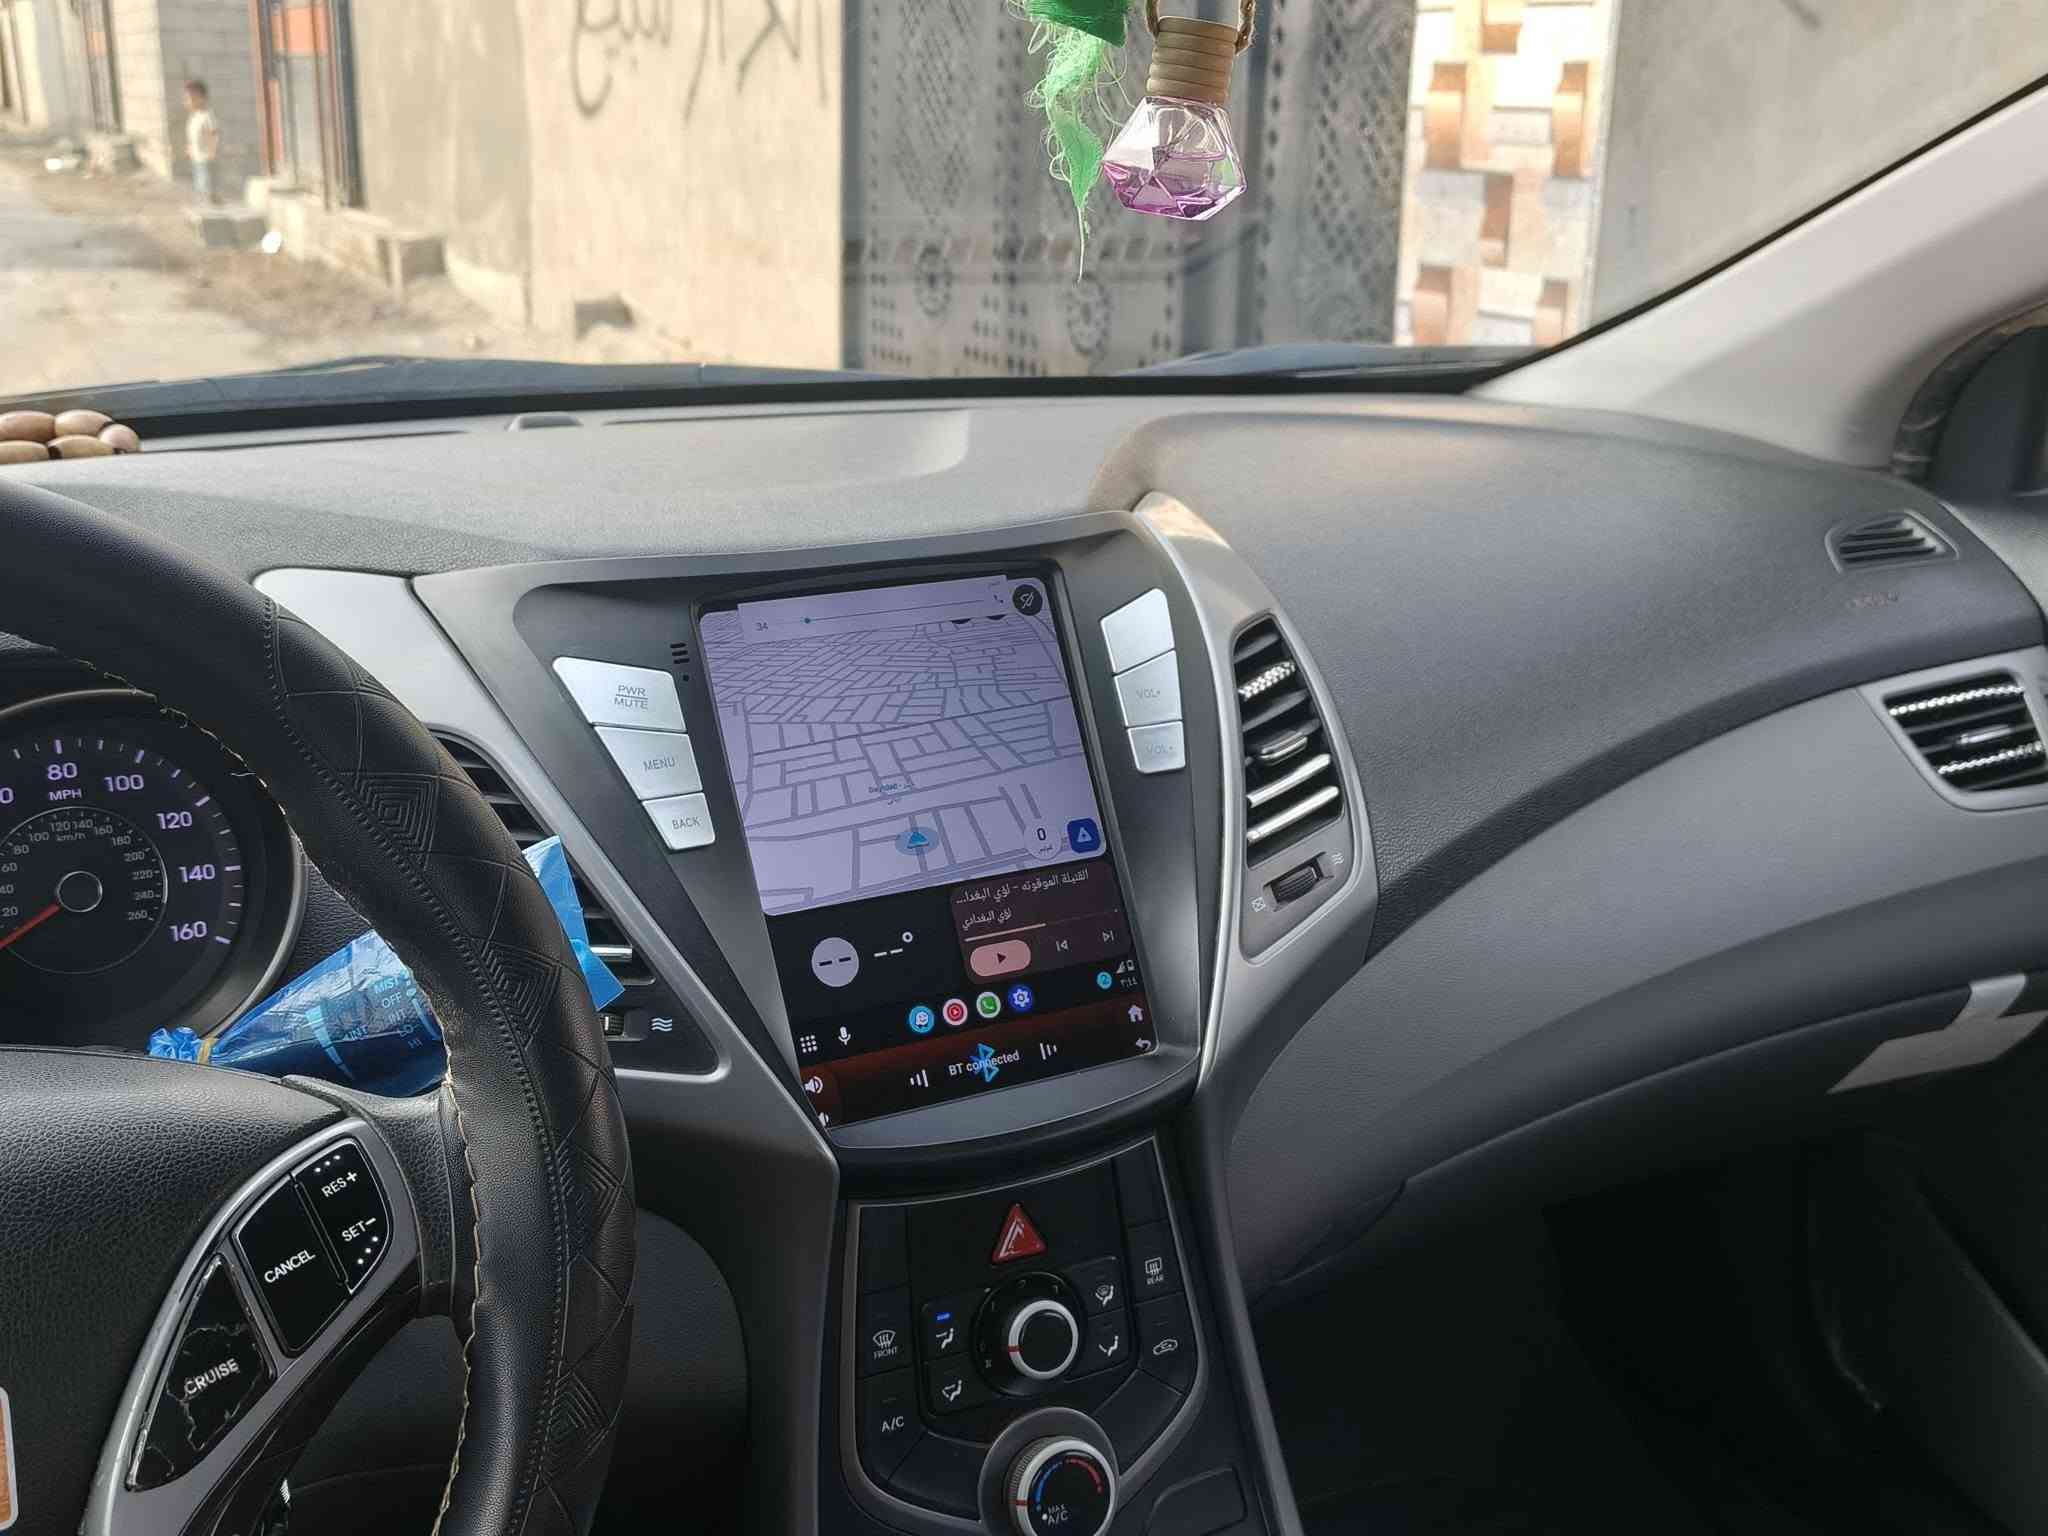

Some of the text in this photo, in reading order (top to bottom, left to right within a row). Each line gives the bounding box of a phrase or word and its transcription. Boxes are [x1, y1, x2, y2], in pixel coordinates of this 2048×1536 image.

[617, 684, 647, 697] PWR
[614, 697, 649, 710] MUTE
[643, 756, 676, 772] MENU
[47, 762, 78, 781] 80
[104, 774, 145, 793] 100
[49, 788, 82, 801] MPH
[50, 820, 71, 832] 120
[72, 818, 94, 831] 140
[157, 811, 193, 830] 120
[672, 816, 701, 830] BACK
[94, 823, 113, 836] 160
[1036, 827, 1047, 841] 0
[29, 831, 50, 843] 100
[112, 835, 131, 847] 180
[14, 844, 30, 856] 80
[124, 851, 145, 862] 200
[1, 862, 18, 873] 60
[179, 864, 216, 883] 140
[2, 906, 18, 917] 20
[170, 921, 207, 942] 160
[382, 991, 402, 1009] OFF
[948, 1049, 1021, 1076] BT connected
[263, 1249, 317, 1284] CANCEL
[873, 1346, 898, 1360] FRONT
[184, 1357, 240, 1395] CRUISE
[881, 1416, 905, 1433] A/C
[1048, 1504, 1065, 1514] MAX
[1047, 1510, 1069, 1527] A/C
